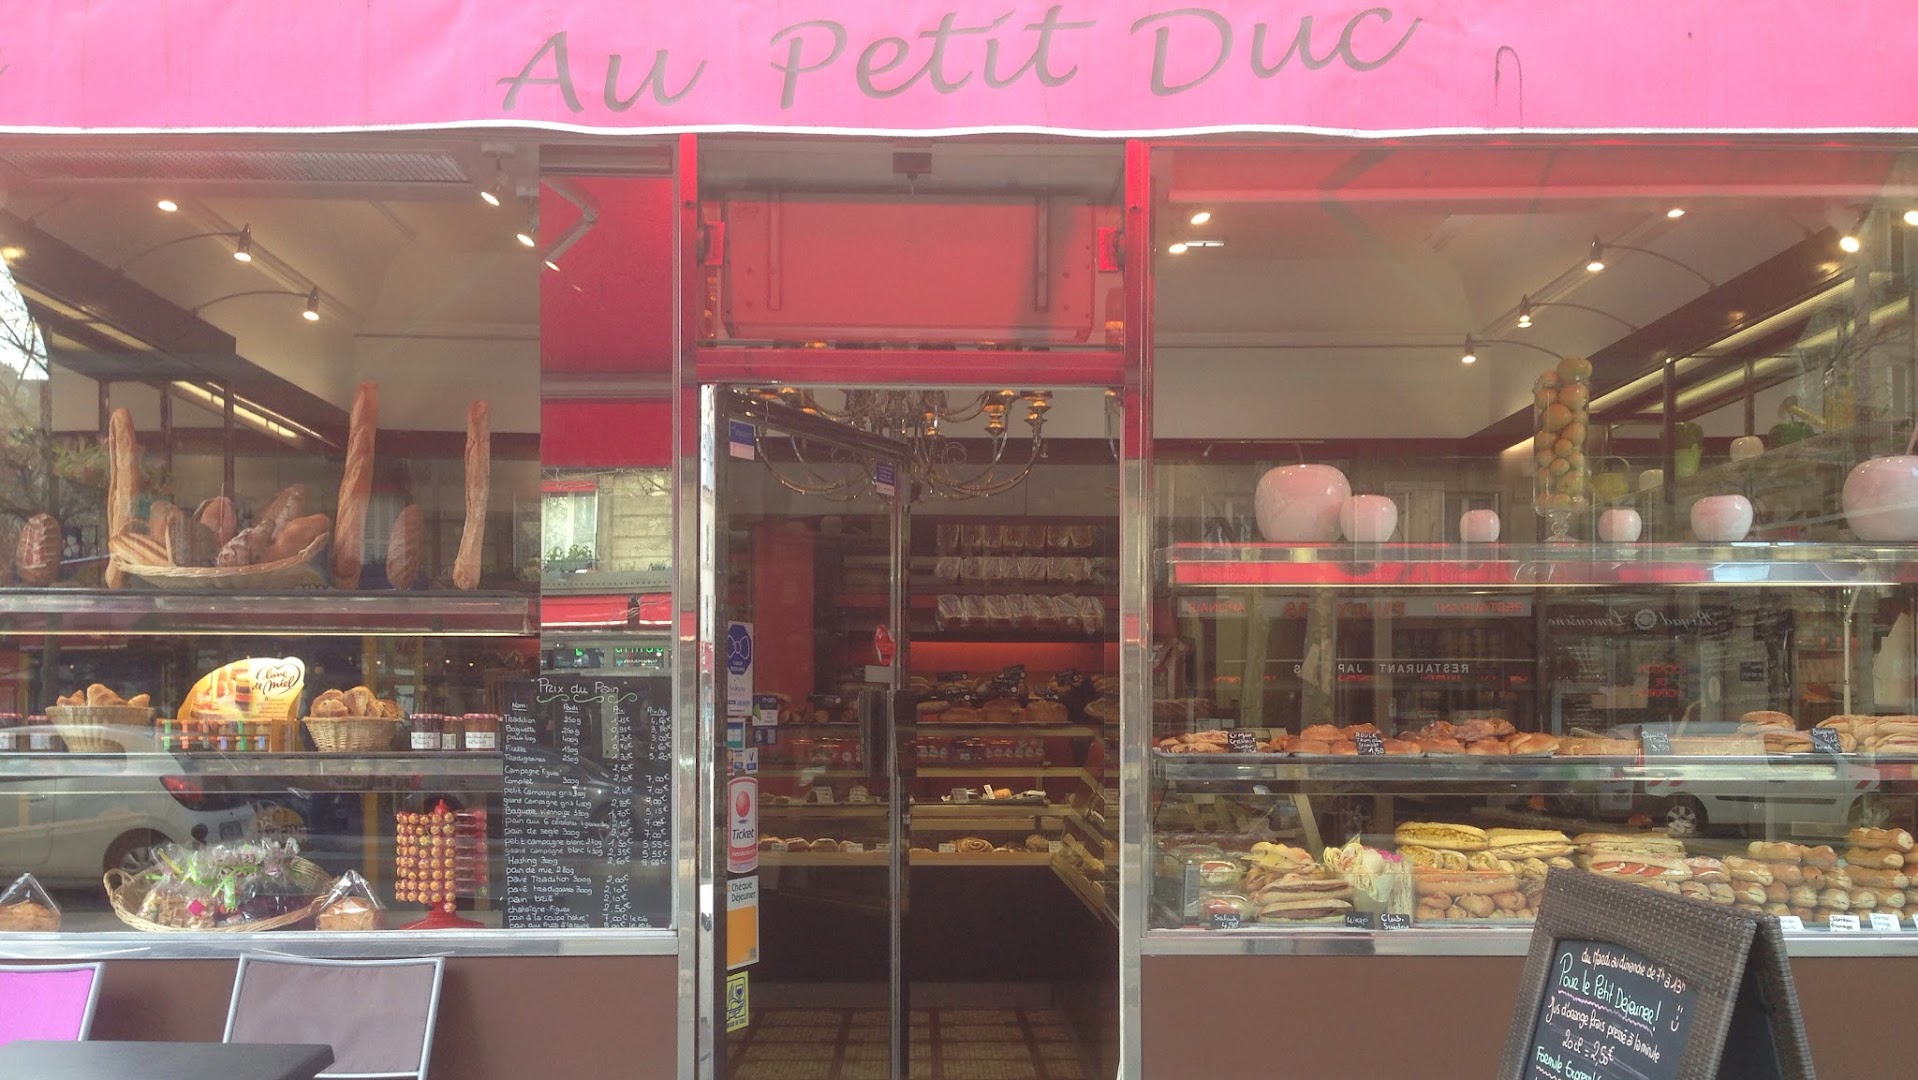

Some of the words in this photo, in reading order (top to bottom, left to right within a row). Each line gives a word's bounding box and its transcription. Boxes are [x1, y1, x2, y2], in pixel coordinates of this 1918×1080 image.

[496, 31, 707, 113] Au
[770, 4, 1097, 109] Petit
[1130, 5, 1422, 97] Duc
[537, 677, 564, 694] Prix
[570, 683, 588, 694] du
[594, 681, 619, 694] Pain
[504, 765, 540, 776] Campagne
[504, 776, 534, 785] Complet
[505, 818, 524, 827] pain
[543, 817, 549, 825] 6
[504, 828, 523, 837] pain
[526, 827, 537, 835] de
[732, 828, 755, 840] Ticket
[525, 866, 536, 874] de
[731, 881, 753, 892] Chèque
[508, 896, 528, 906] pain
[731, 891, 757, 904] Déjeuner
[1582, 947, 1592, 965] du
[1610, 956, 1619, 968] au
[1619, 953, 1646, 976] dimanche
[1646, 964, 1657, 980] de
[1663, 973, 1673, 989] à
[1558, 952, 1579, 991] Pour
[1581, 969, 1591, 996] le
[1593, 974, 1615, 1004] Petit
[1588, 1008, 1606, 1033] frais
[1590, 1040, 1616, 1066] 2,50€
[1535, 1046, 1563, 1074] Formule
